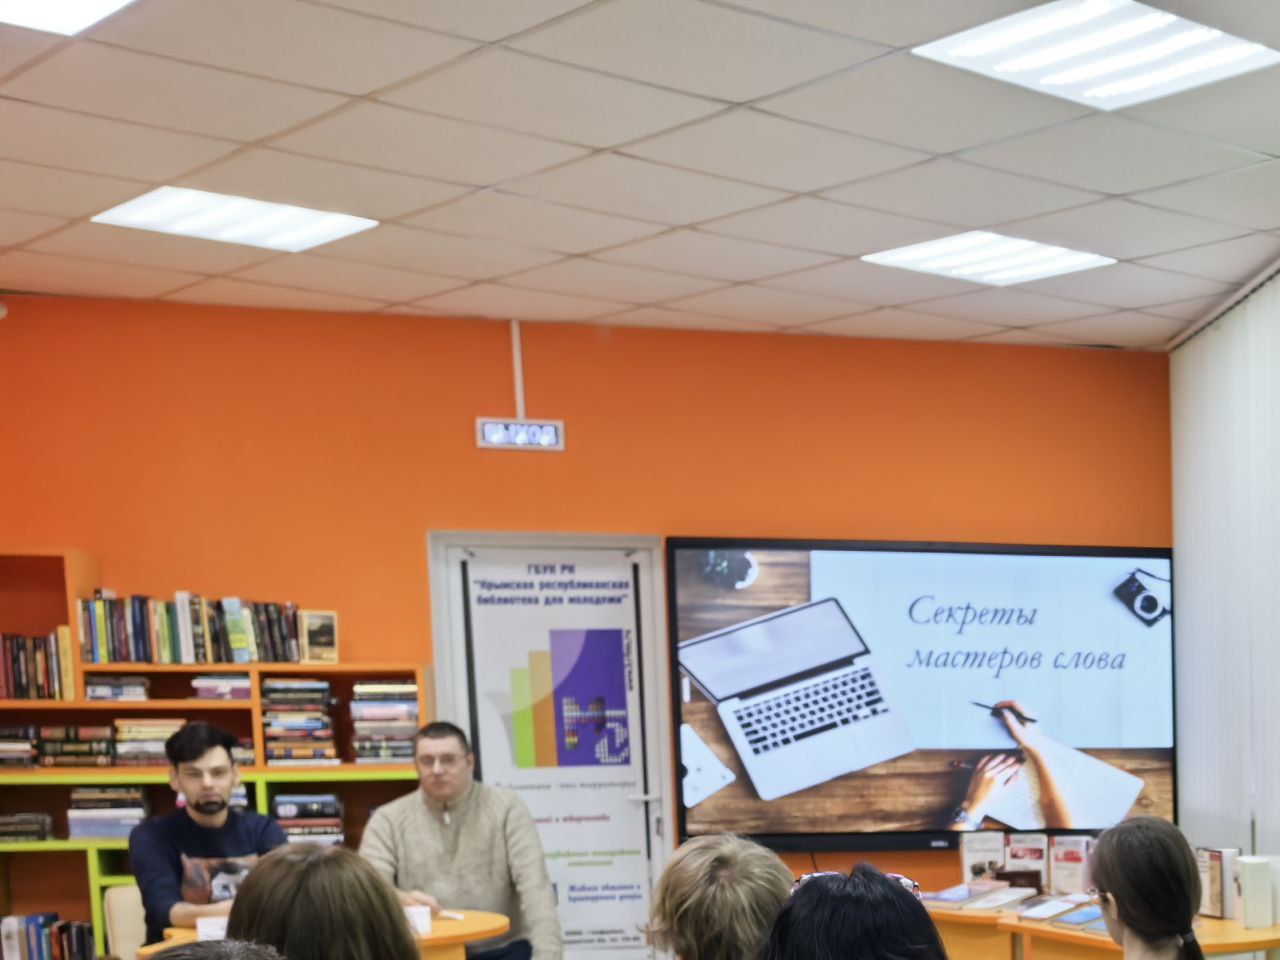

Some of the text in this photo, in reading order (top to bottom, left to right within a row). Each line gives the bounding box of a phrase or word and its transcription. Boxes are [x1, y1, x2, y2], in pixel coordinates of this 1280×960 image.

[539, 579, 630, 591] республиканская
[476, 594, 540, 606] библиотека
[543, 596, 564, 606] для
[907, 594, 1039, 635] Секреты
[905, 646, 1127, 679] мастеров слова
